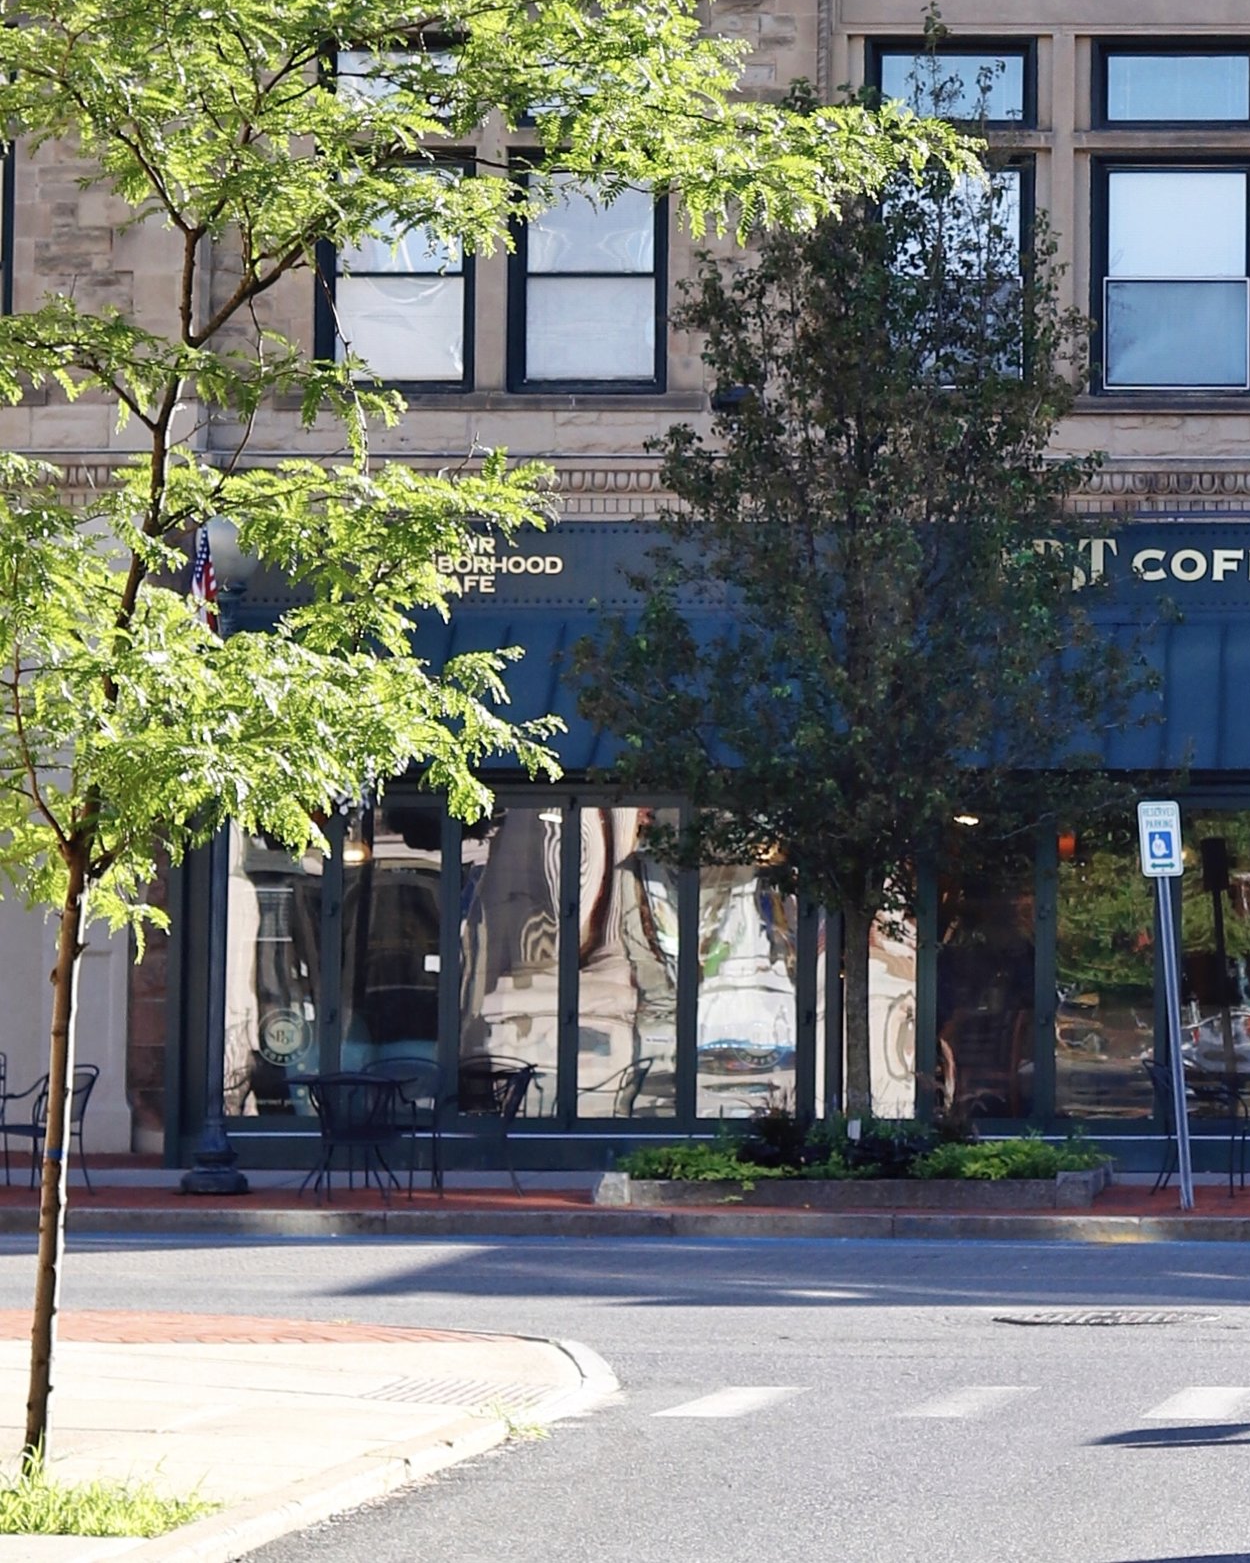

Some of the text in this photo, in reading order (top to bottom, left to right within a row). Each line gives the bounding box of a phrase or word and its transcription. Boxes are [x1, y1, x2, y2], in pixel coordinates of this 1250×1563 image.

[449, 575, 496, 594] AFE
[1141, 806, 1176, 817] RESERVED
[1145, 819, 1174, 829] PARKING
